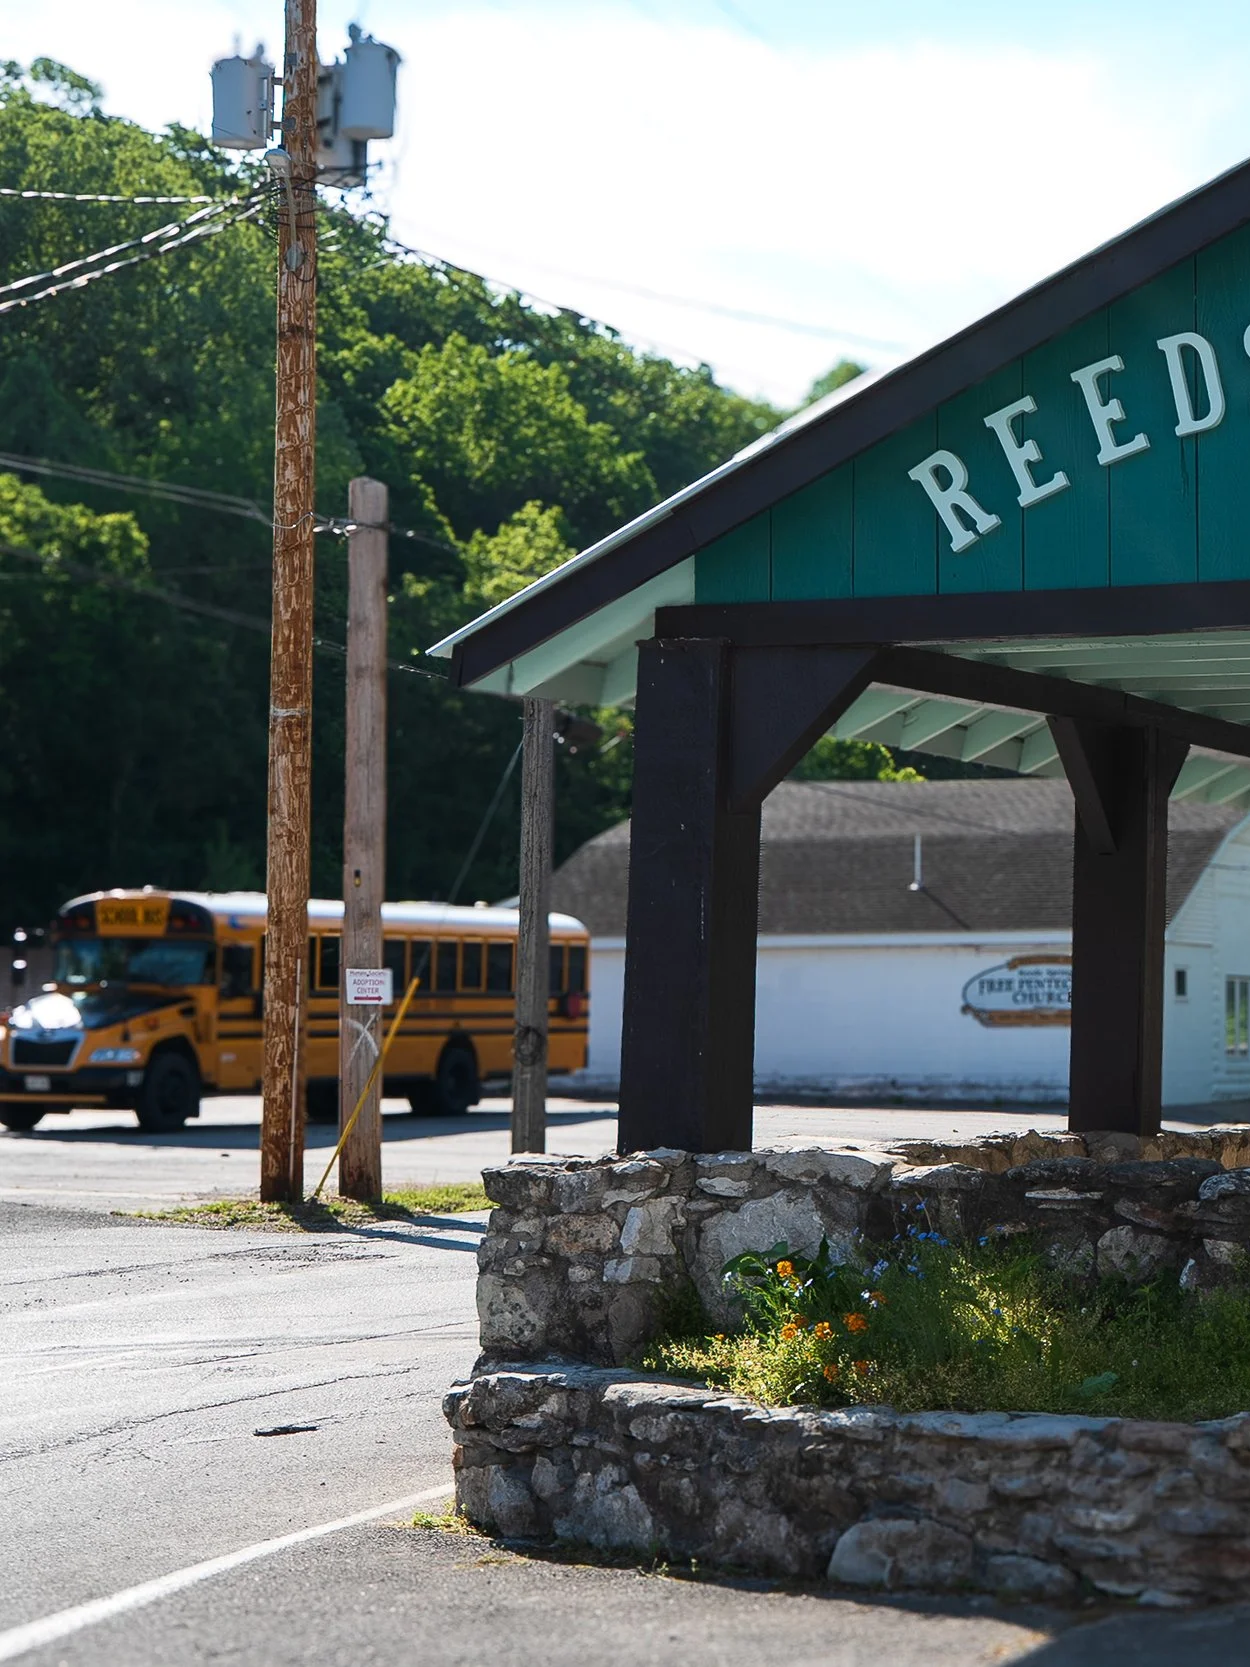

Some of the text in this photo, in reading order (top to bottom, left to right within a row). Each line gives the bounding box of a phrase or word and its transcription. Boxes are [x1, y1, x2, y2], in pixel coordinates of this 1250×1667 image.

[100, 906, 163, 925] SCHOOL BUS
[978, 978, 1013, 996] FREE
